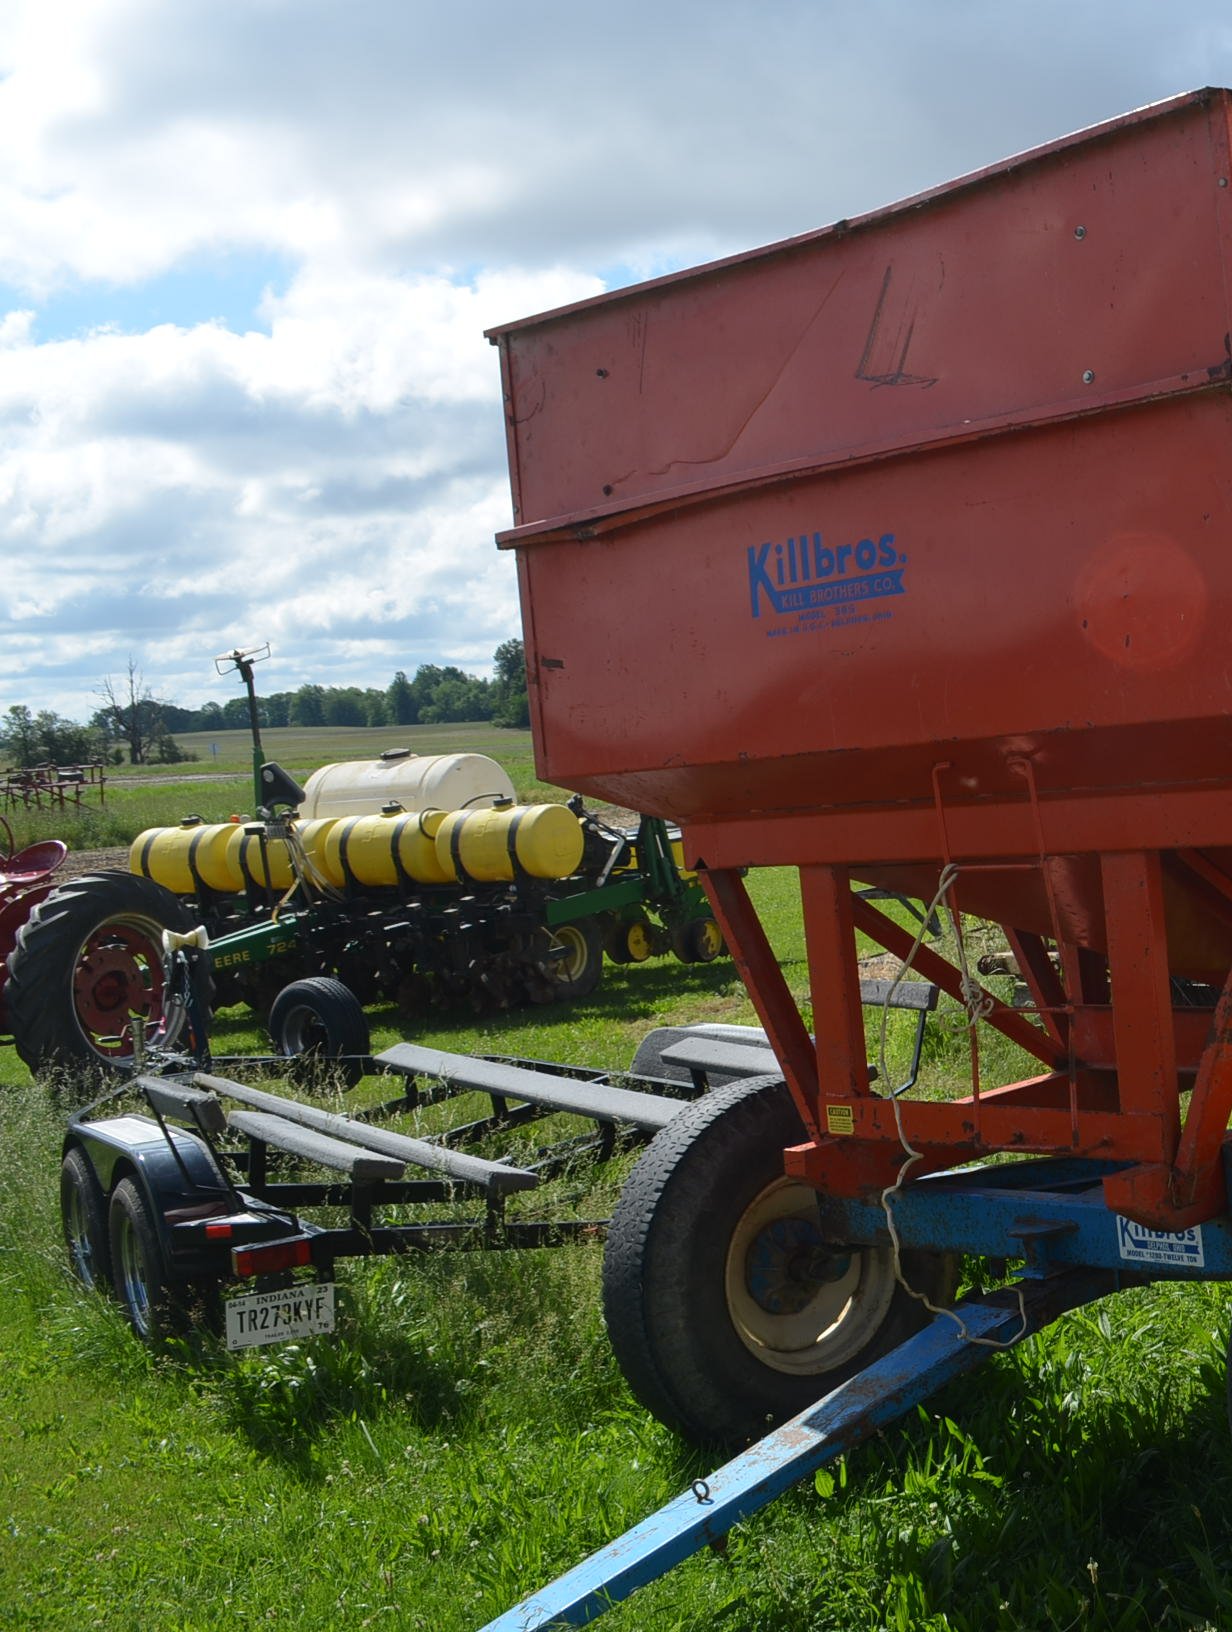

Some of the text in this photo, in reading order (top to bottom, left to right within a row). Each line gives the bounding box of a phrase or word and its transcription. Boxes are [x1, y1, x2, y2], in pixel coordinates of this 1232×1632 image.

[747, 532, 907, 619] Killbros.
[781, 577, 896, 609] KILL BROTHERS CO.
[214, 950, 251, 968] EERE
[1126, 1249, 1145, 1258] MODEL
[1186, 1255, 1197, 1263] TON
[256, 1290, 305, 1305] INDIANA
[316, 1285, 329, 1294] 23
